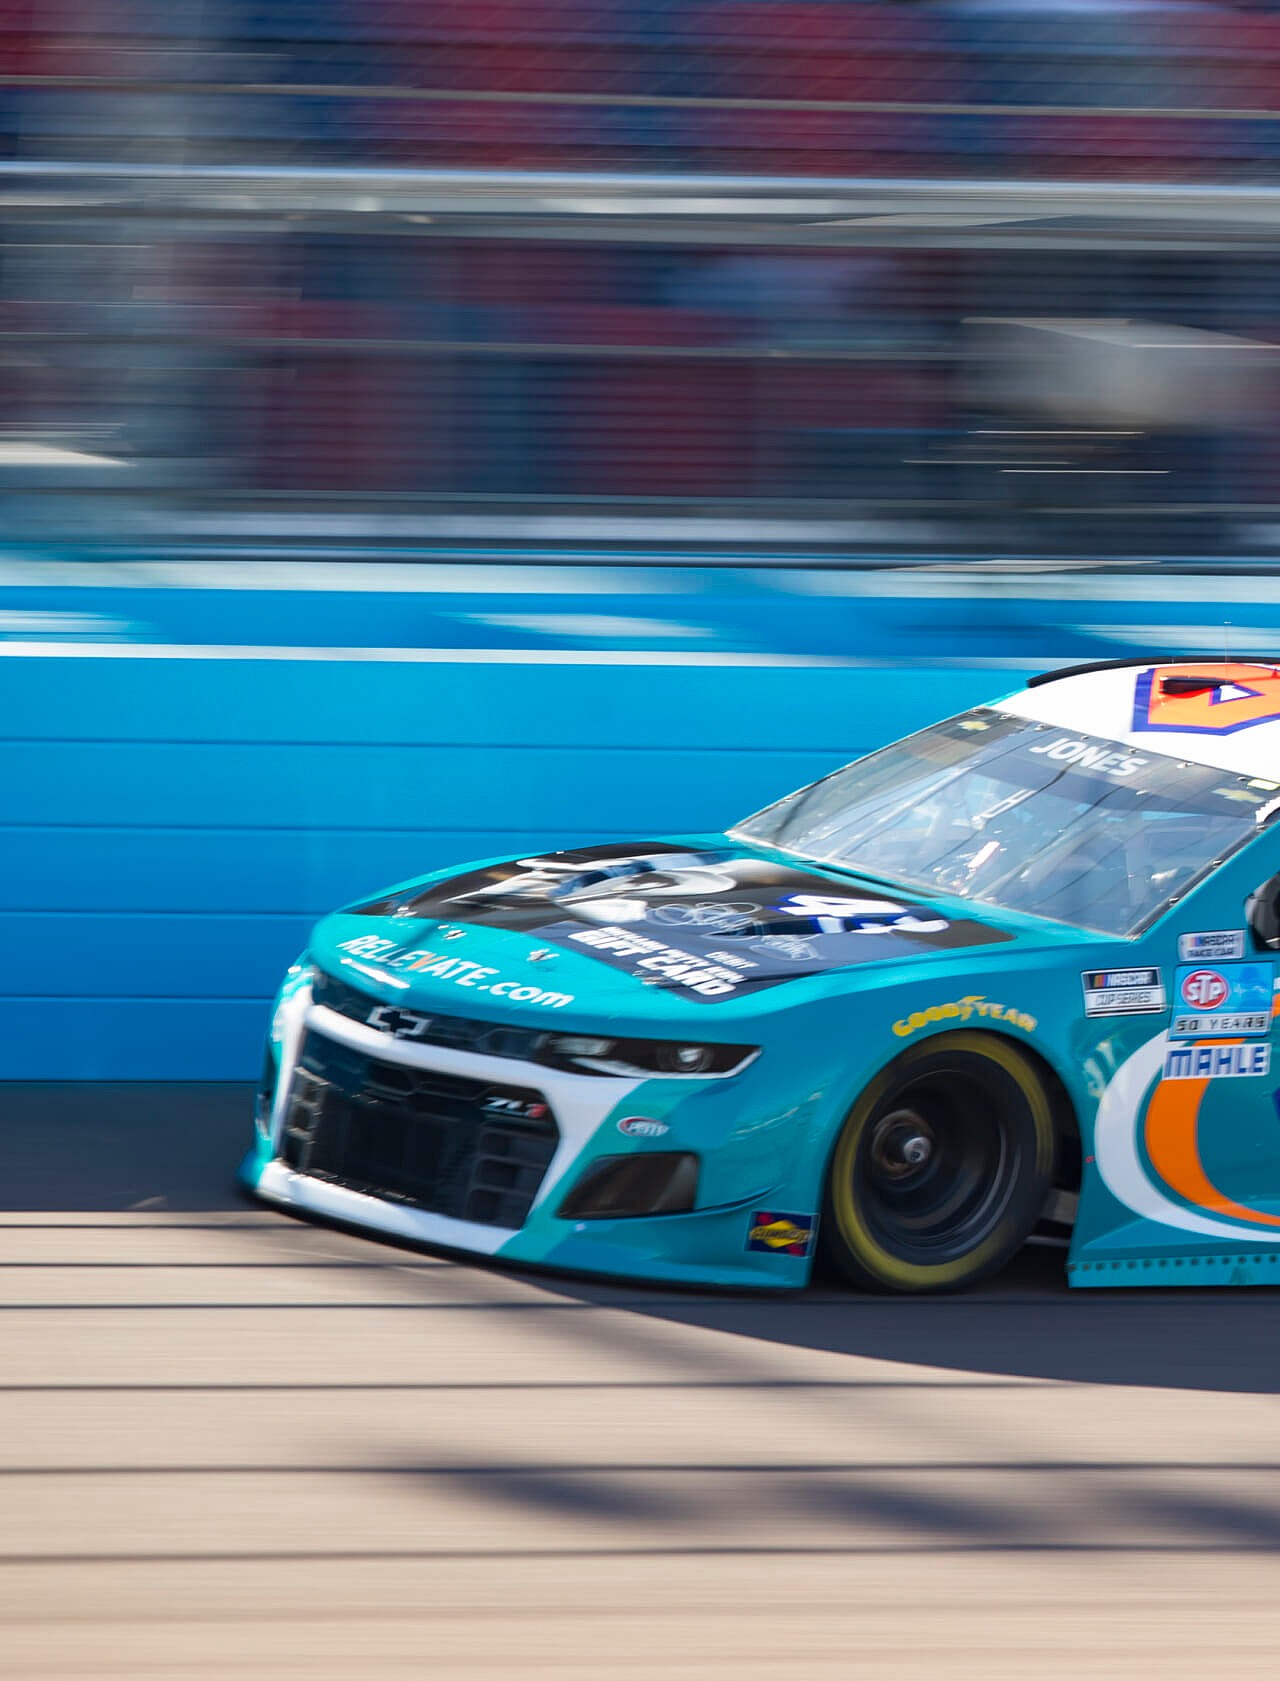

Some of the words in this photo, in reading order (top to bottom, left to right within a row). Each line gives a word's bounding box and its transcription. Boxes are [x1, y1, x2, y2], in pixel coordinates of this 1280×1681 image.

[1028, 738, 1150, 776] JONES
[336, 934, 576, 1009] RELLEVATE.com
[567, 930, 653, 957] GIFT
[637, 956, 737, 996] CARD
[1187, 974, 1225, 1005] STP
[892, 996, 1038, 1037] GOODYEAR
[1176, 1018, 1198, 1032] 50
[1210, 1016, 1265, 1031] YEARS
[1165, 1046, 1266, 1078] MAHLE
